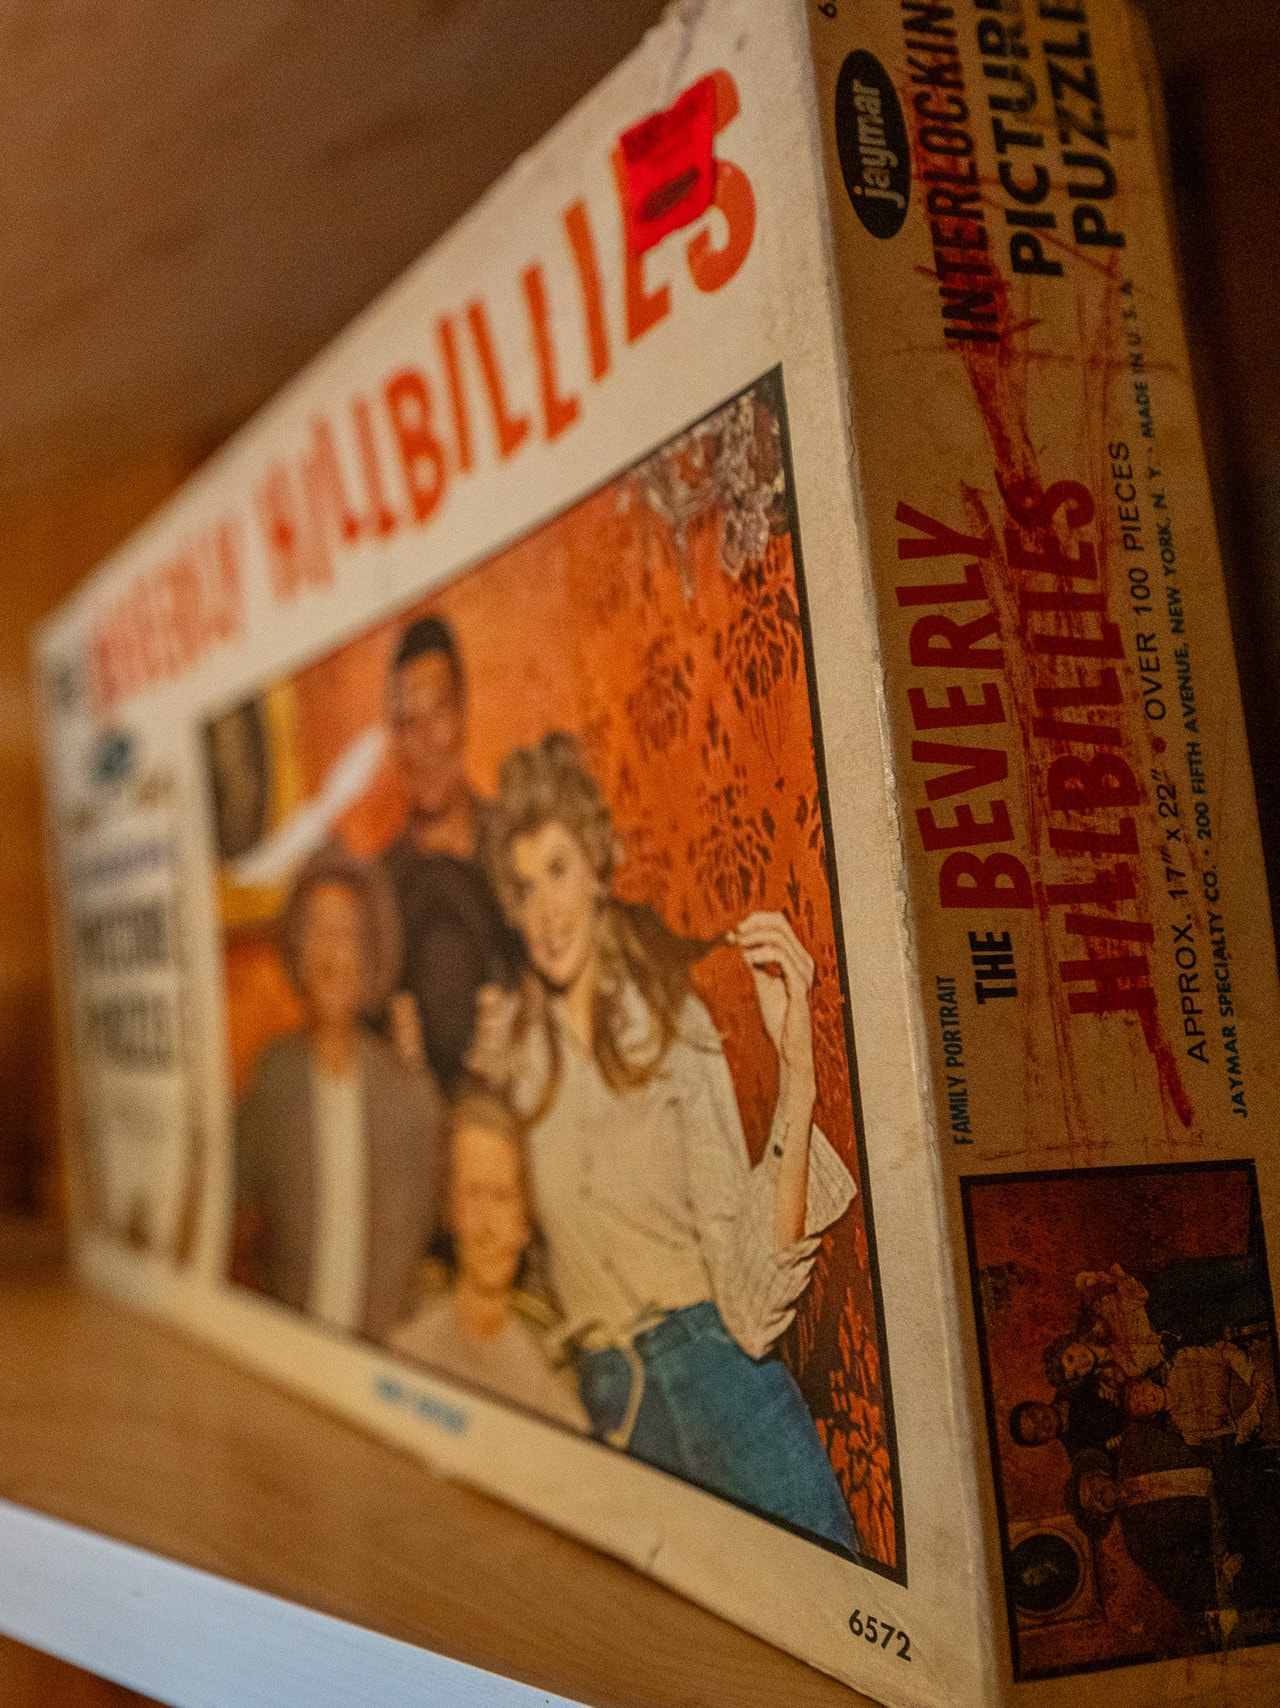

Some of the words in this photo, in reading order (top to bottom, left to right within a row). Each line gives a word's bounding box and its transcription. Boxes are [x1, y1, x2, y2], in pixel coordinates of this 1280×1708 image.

[853, 79, 906, 209] jaymar
[974, 0, 1063, 277] PICTUR
[1129, 352, 1145, 375] IN
[1132, 380, 1154, 439] MADE
[1108, 440, 1145, 552] PIECES
[1127, 566, 1153, 616] 100
[1166, 586, 1186, 635] NEW
[894, 500, 1035, 910] BEVERLY
[1136, 631, 1167, 721] OVER
[998, 479, 1158, 1015] HILLBILLIES
[1186, 741, 1206, 795] FIFTH
[1194, 801, 1213, 841] 200
[1202, 865, 1220, 903] CO.
[968, 931, 1019, 1005] THE
[1172, 914, 1209, 1065] APPROX.
[1207, 910, 1235, 1018] SPECIALTY
[936, 975, 966, 1070] PORTRAIT
[947, 1075, 974, 1146] FAMILY
[1220, 1024, 1248, 1119] JAYMAR
[848, 1608, 912, 1663] 6572
